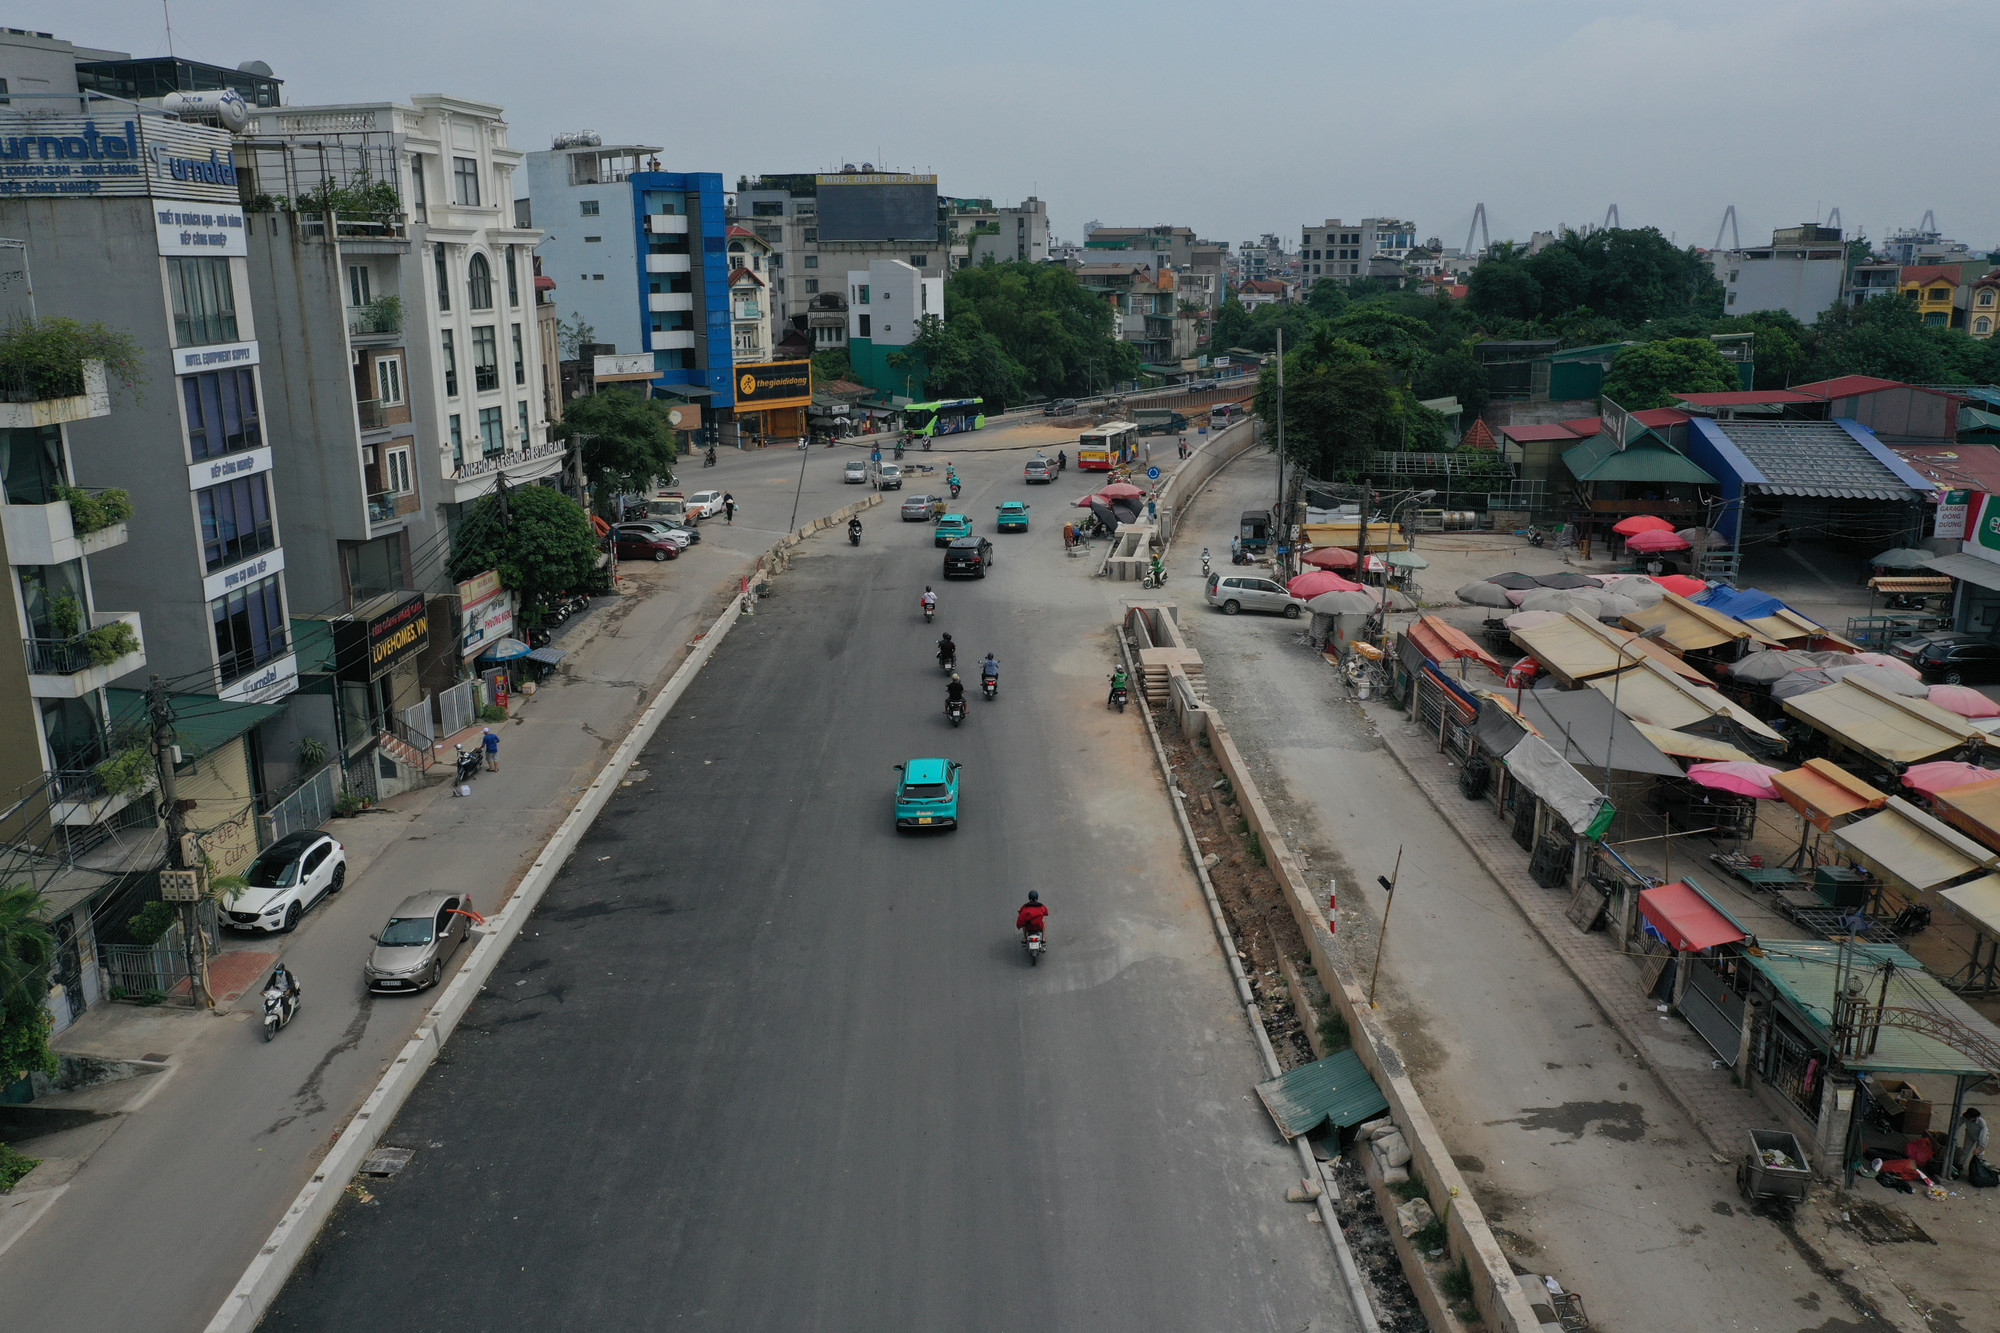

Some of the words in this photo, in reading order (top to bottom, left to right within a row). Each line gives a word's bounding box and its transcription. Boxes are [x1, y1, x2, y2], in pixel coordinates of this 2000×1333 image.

[185, 353, 202, 367] HOTEL
[202, 350, 231, 366] EQUIPMENT
[231, 348, 250, 361] SUPPLY
